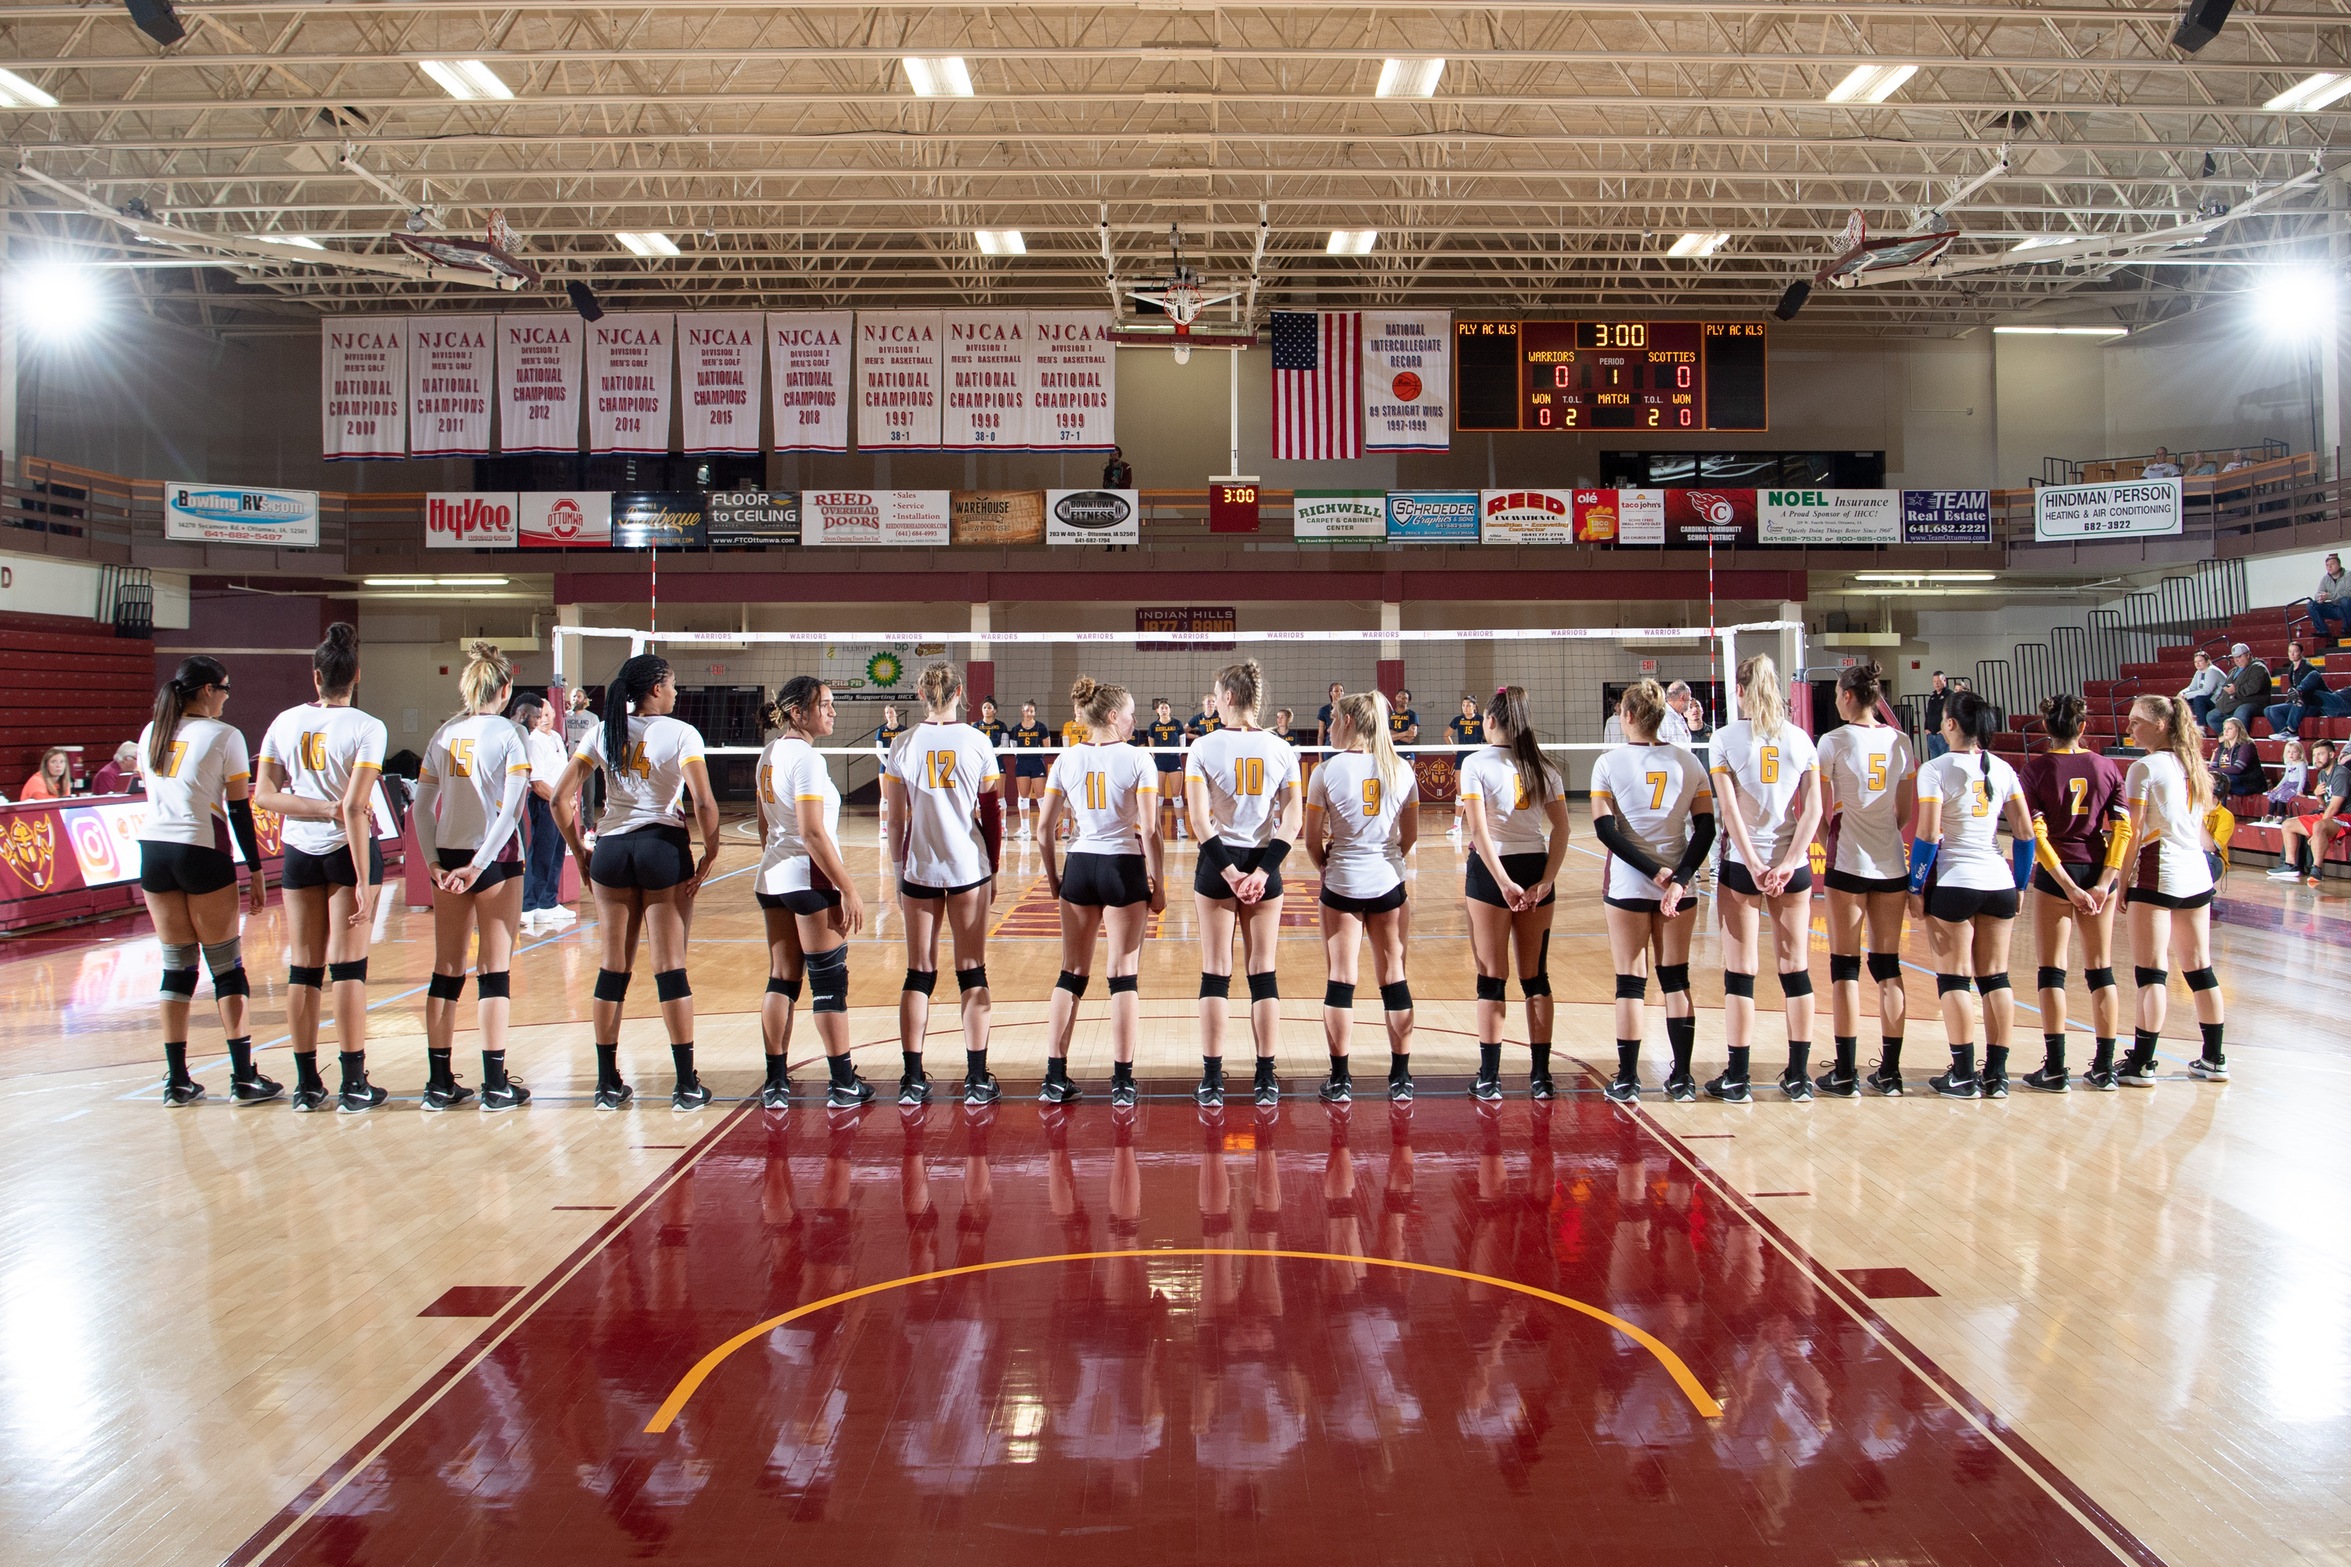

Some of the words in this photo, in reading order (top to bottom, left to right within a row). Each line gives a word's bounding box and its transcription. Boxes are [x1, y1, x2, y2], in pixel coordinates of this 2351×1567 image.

[689, 329, 753, 345] NJCAA
[864, 325, 934, 342] NJCAA
[951, 323, 1023, 340] NJCAA
[1038, 324, 1107, 341] NJCAA
[1385, 324, 1426, 336] NATIONAL
[1459, 324, 1477, 335] PLY
[1482, 324, 1494, 335] AC
[1498, 324, 1517, 335] KLS
[1596, 324, 1644, 346] 3:00
[1706, 325, 1724, 335] PLY
[1729, 325, 1741, 335] AC
[1745, 325, 1764, 335] KLS
[331, 333, 400, 349] NJCAA
[778, 329, 842, 346] NJCAA
[1370, 339, 1442, 352] INTERCOLLEGIATE
[891, 357, 933, 365] BASKETBALL
[978, 355, 1021, 363] BASKETBALL
[1390, 355, 1422, 368] RECORD
[1528, 351, 1575, 362] WARRIORS
[1599, 357, 1625, 365] PERIOD
[1648, 352, 1696, 362] SCOTTIES
[602, 376, 655, 391] NATIONAL
[697, 370, 744, 386] NATIONAL
[786, 372, 833, 387] NATIONAL
[868, 372, 930, 387] NATIONAL
[955, 372, 1017, 387] NATIONAL
[1041, 372, 1101, 387] NATIONAL
[1555, 365, 1569, 388] 0
[1677, 365, 1690, 388] 0
[335, 380, 392, 395] NATIONAL
[694, 389, 747, 406] CHAMPIONS
[783, 391, 836, 407] CHAMPIONS
[865, 391, 934, 407] CHAMPIONS
[950, 392, 1023, 408] CHAMPIONS
[1035, 392, 1107, 408] CHAMPIONS
[1532, 393, 1551, 404] WON
[1598, 393, 1630, 404] MATCH
[1672, 393, 1692, 404] WON
[329, 401, 398, 416] CHAMPIONS
[529, 405, 550, 419] 2012
[1369, 406, 1379, 418] 89
[1382, 405, 1420, 418] STRAIGHT
[1422, 406, 1444, 418] WINS
[615, 417, 641, 432] 2014
[710, 410, 733, 425] 2015
[799, 410, 820, 425] 2018
[885, 411, 914, 426] 1997
[971, 413, 1000, 428] 1998
[1056, 413, 1085, 428] 1999
[1540, 408, 1551, 426] 0
[1566, 408, 1577, 426] 2
[1648, 408, 1659, 426] 2
[1680, 408, 1691, 426] 0
[438, 418, 464, 432] 2011
[1387, 420, 1427, 432] 1997-1999
[891, 431, 910, 441] 38-1
[975, 431, 996, 441] 38-0
[1060, 431, 1080, 441] 37-1
[178, 490, 239, 512] Bowling
[712, 493, 769, 506] FLOOR
[814, 493, 873, 506] REED
[1224, 489, 1255, 503] 3:00
[1577, 492, 1598, 504] olé
[1768, 491, 1829, 507] NOEL
[1834, 496, 1889, 507] Insurance
[1933, 492, 1987, 509] TEAM
[2045, 486, 2172, 508] HINDMAN/PERSON
[821, 506, 879, 515] OVERHEAD
[897, 502, 925, 510] Service
[955, 501, 1010, 514] WAREHOUSE
[1070, 500, 1115, 508] DOWNTOWN
[1298, 503, 1382, 519] RICHWELL
[1396, 502, 1475, 515] SCHROEDER
[1487, 491, 1567, 517] REED
[1640, 501, 1661, 509] john's
[547, 511, 584, 527] OTTUMWA
[712, 511, 730, 522] to
[734, 510, 796, 522] CEILING
[897, 512, 941, 520] Installation
[1070, 511, 1115, 520] FITNESS
[1714, 506, 1727, 520] C
[1780, 510, 1787, 518] A
[1789, 510, 1809, 518] Proud
[1813, 510, 1840, 519] Sponsor
[1843, 510, 1851, 519] of
[1854, 510, 1878, 518] IHCC!
[1907, 510, 1938, 521] Real
[1944, 510, 1987, 521] Estate
[2045, 510, 2080, 520] HEATING
[2083, 510, 2089, 518] &
[2093, 508, 2106, 517] AIR
[2110, 504, 2172, 516] CONDITIONING
[823, 516, 880, 531] DOORS
[1412, 514, 1453, 526] Graphics
[2084, 520, 2131, 531] 682-3922
[204, 531, 282, 540] 641-682-5497
[1909, 524, 1986, 533] 641.682.2221
[1139, 611, 1187, 619] INDIAN
[1193, 611, 1233, 619] HILLS
[1162, 731, 1168, 740] 9
[1464, 726, 1473, 735] 15
[1025, 737, 1030, 745] 6
[301, 731, 328, 771] 16
[449, 738, 475, 778] 15
[926, 749, 956, 789] 12
[1760, 745, 1779, 783] 6
[1234, 757, 1264, 796] 10
[1868, 753, 1887, 791] 5
[1086, 771, 1107, 810] 11
[1362, 778, 1381, 817] 9
[1646, 771, 1667, 809] 7
[2070, 777, 2089, 815] 2
[1971, 780, 1989, 818] 3
